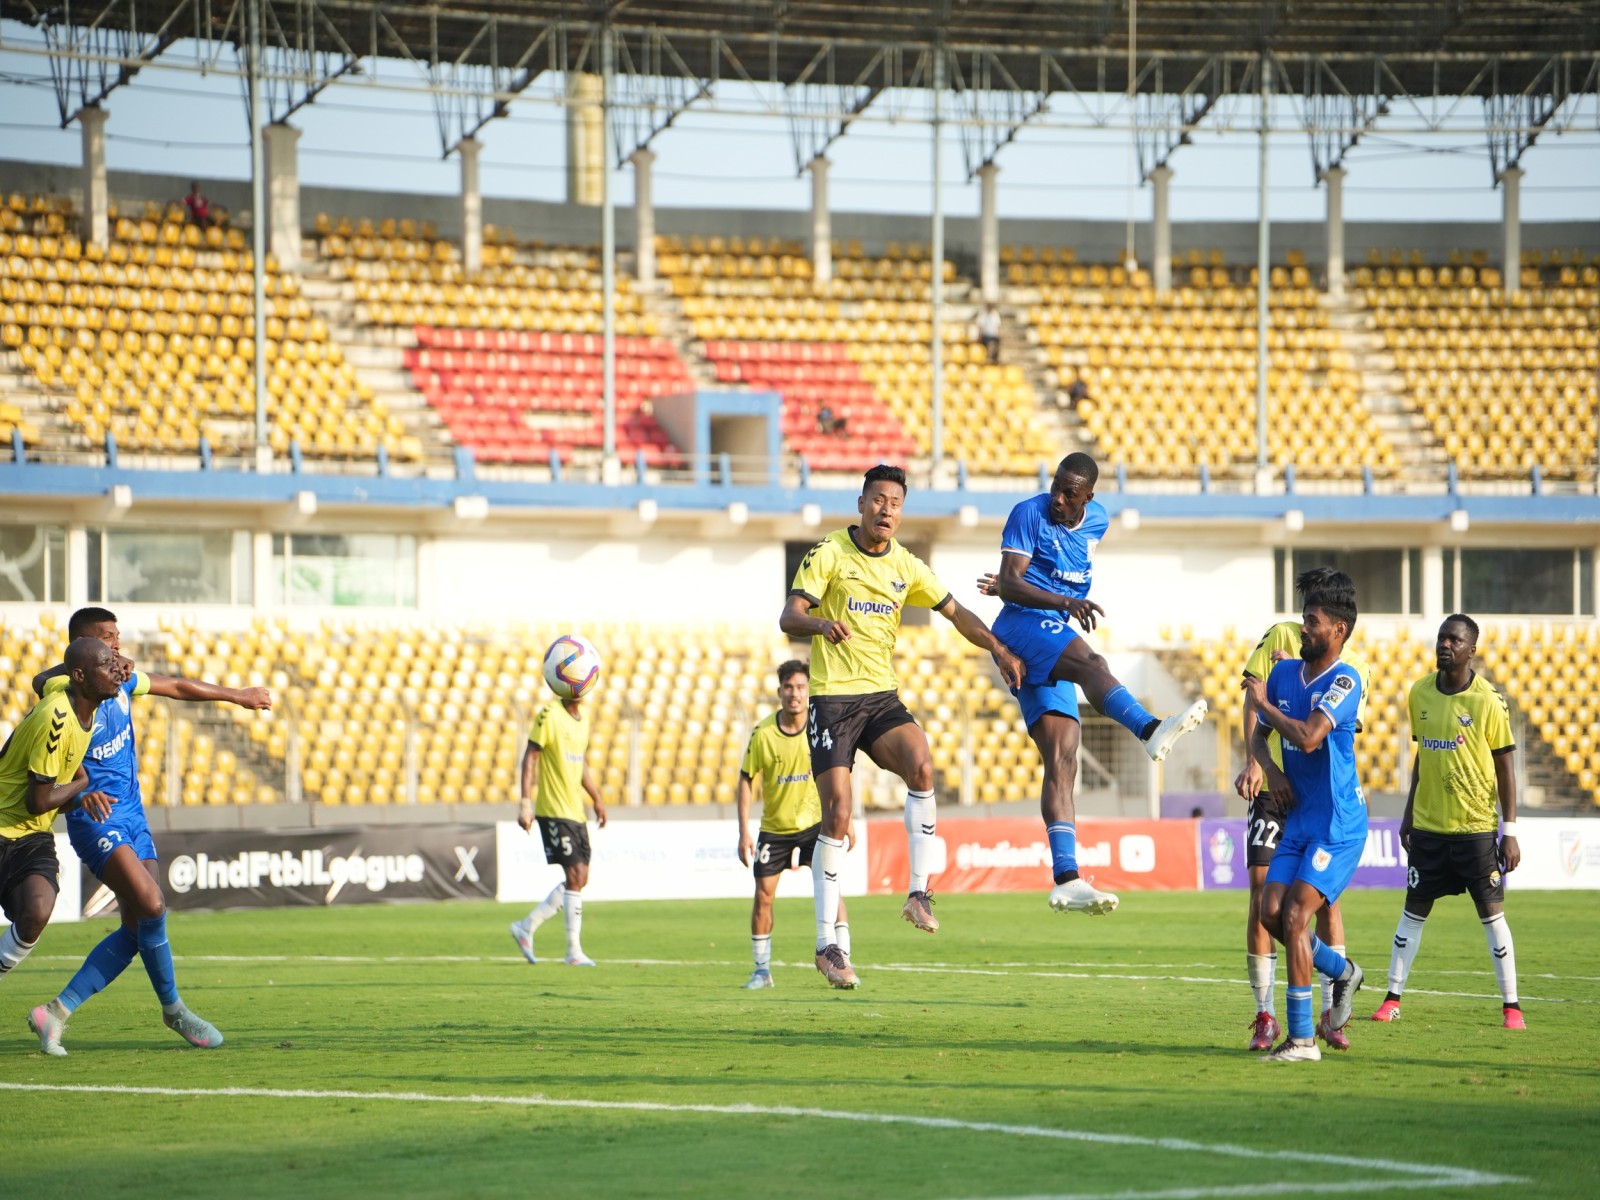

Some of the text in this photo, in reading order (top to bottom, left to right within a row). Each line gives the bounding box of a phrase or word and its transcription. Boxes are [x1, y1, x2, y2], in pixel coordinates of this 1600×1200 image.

[848, 597, 893, 615] Livpure
[98, 829, 123, 852] 37
[1252, 819, 1279, 849] 22
[562, 836, 573, 857] 5
